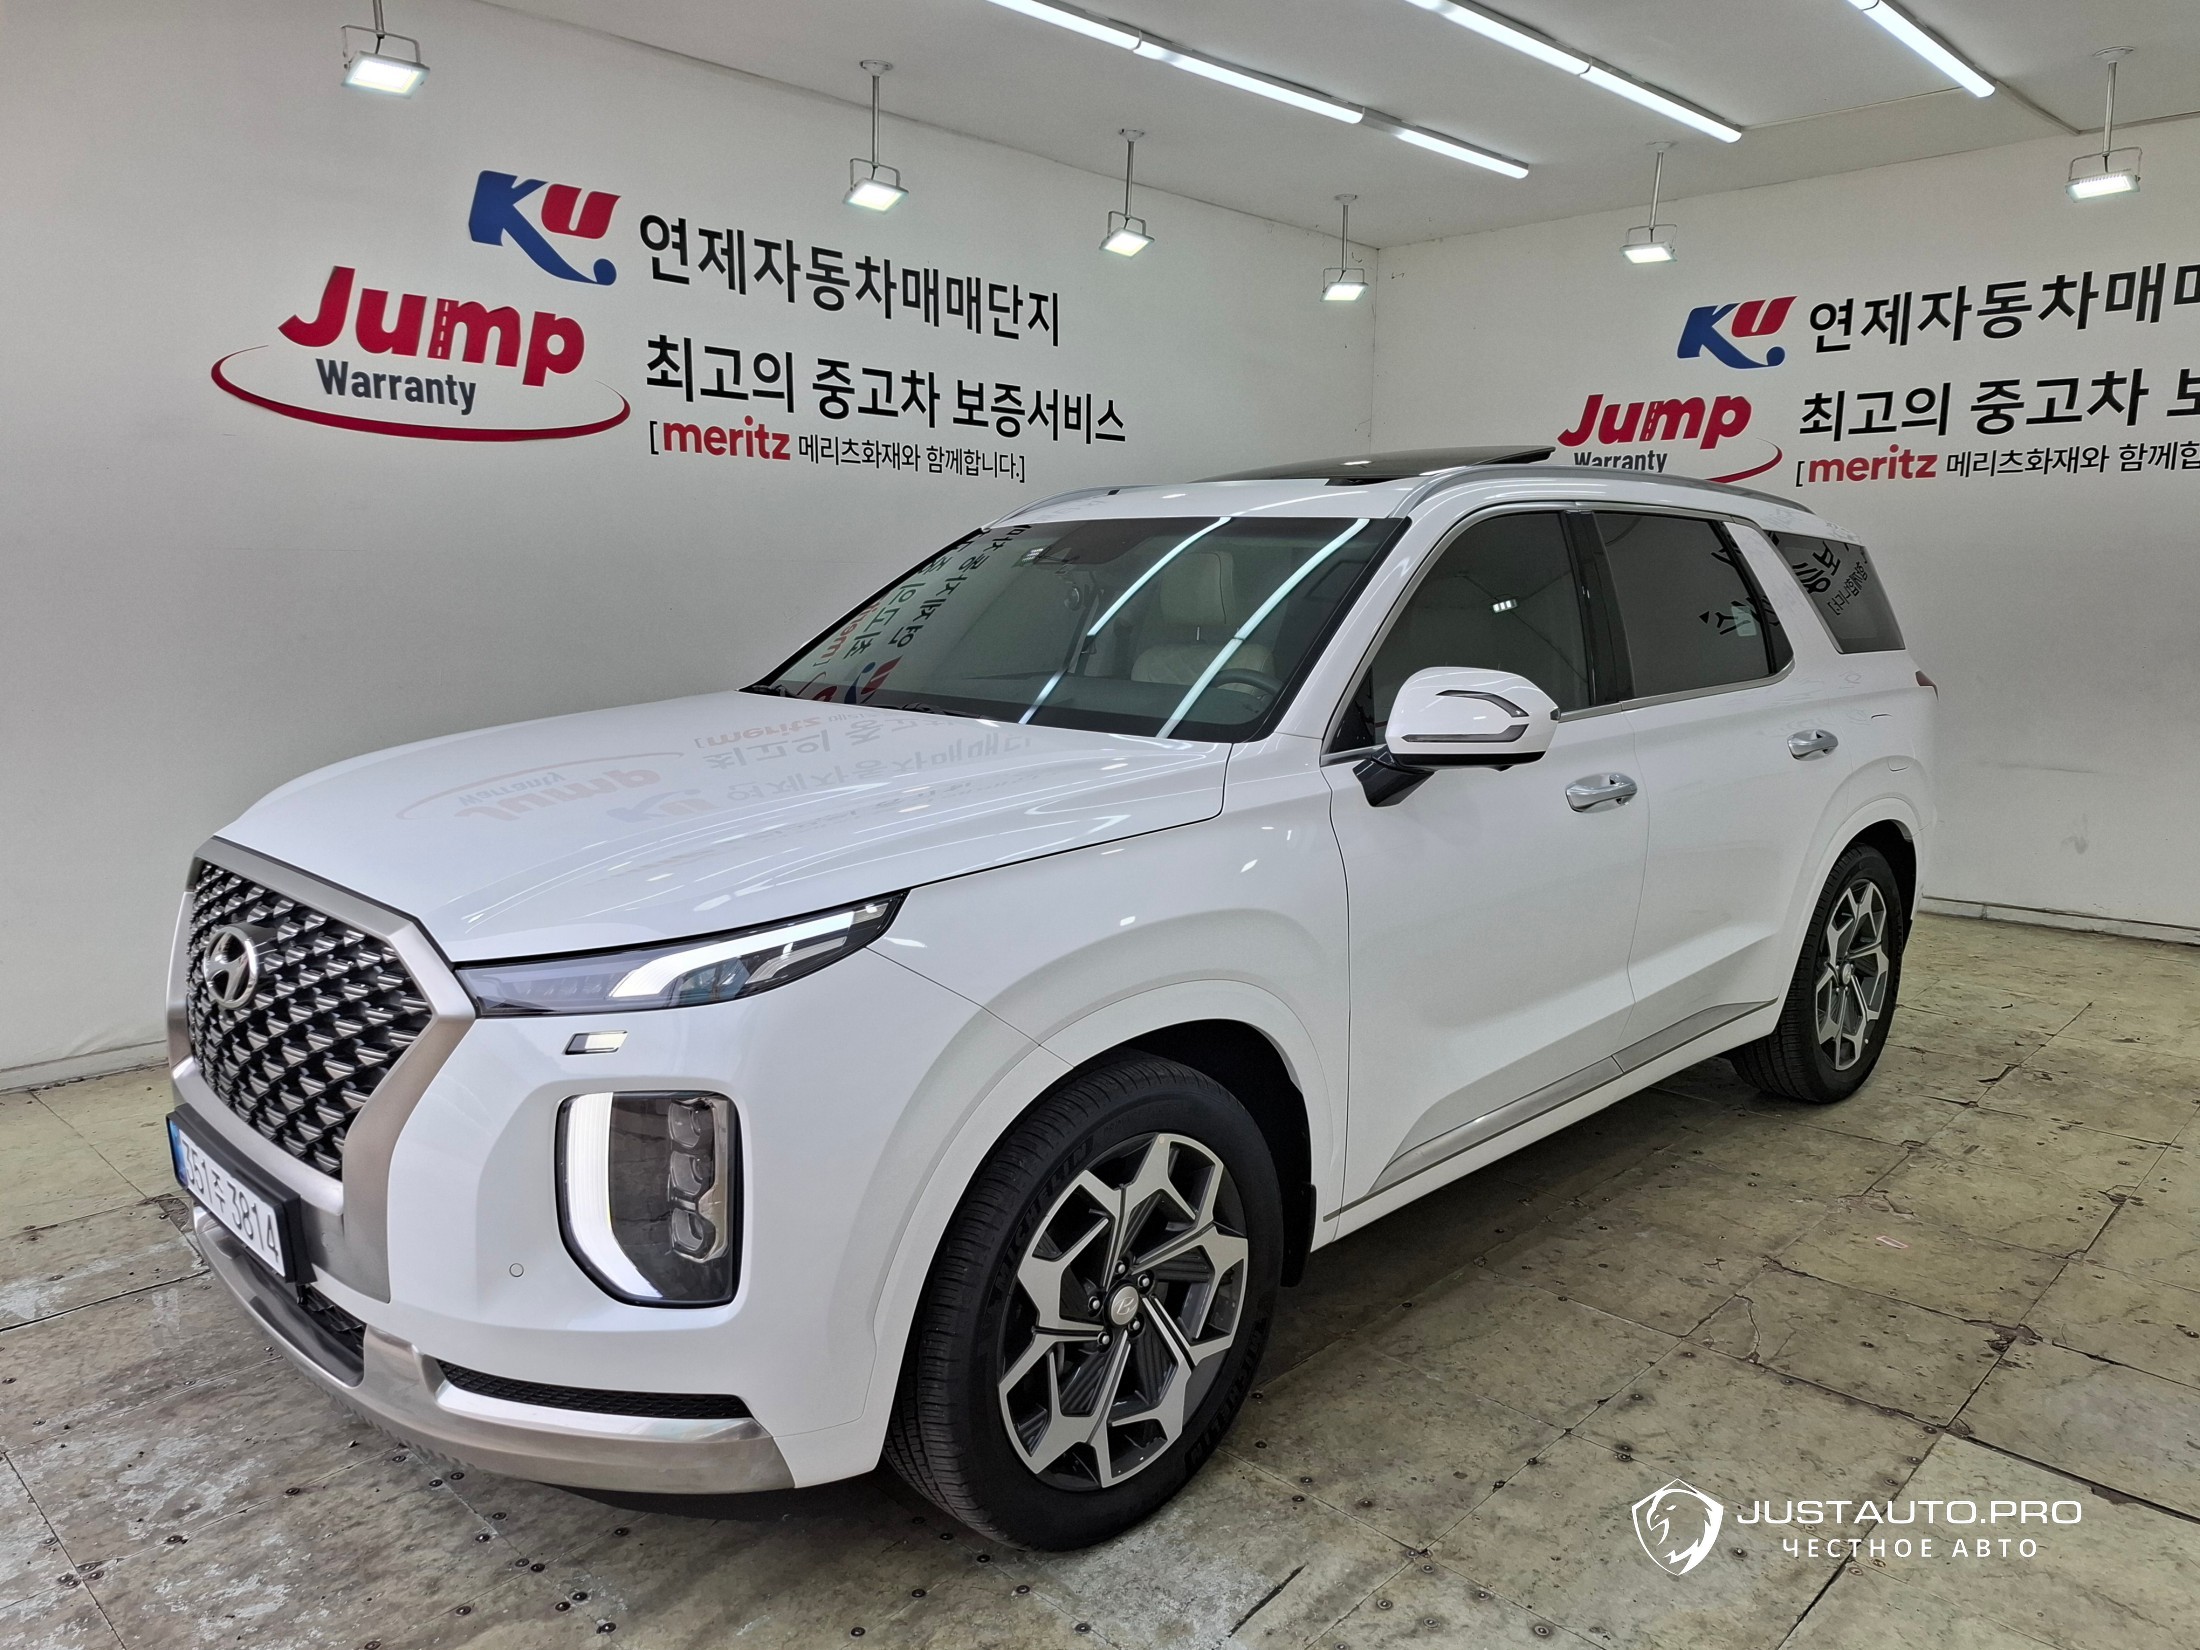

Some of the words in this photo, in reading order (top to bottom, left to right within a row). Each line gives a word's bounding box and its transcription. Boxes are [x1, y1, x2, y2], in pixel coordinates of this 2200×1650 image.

[640, 214, 1060, 347] 연제자동차매매단지
[277, 264, 585, 388] Jump
[315, 357, 477, 416] Warranty
[646, 333, 795, 414] 최고의
[812, 356, 942, 429] 중고차
[952, 379, 1126, 445] 보증서비스
[1799, 382, 1952, 442] 최고의
[1970, 368, 2150, 435] 중고차
[1557, 393, 1752, 450] Jump
[798, 434, 921, 473] 메리츠화재와
[926, 444, 1026, 484] 함께합니다.]
[1946, 444, 2110, 478] 메리츠화재와
